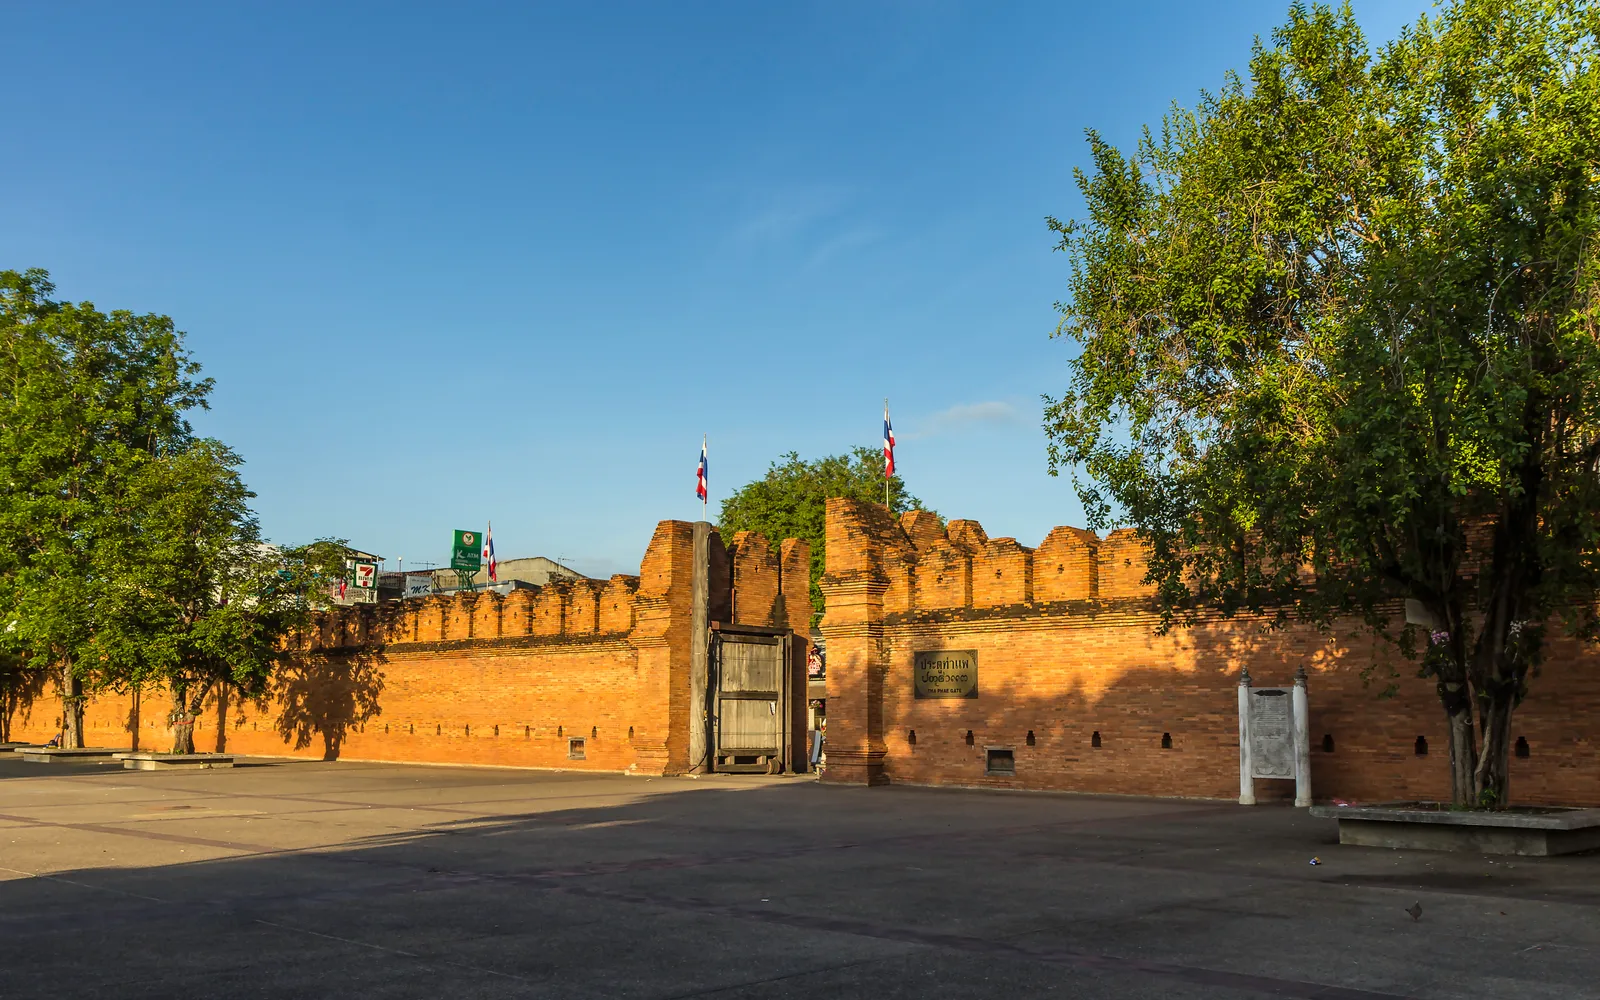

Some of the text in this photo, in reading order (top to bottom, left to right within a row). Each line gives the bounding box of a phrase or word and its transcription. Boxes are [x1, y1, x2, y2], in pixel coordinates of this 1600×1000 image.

[456, 549, 466, 559] K
[921, 657, 968, 674] ประตูท่าแพ
